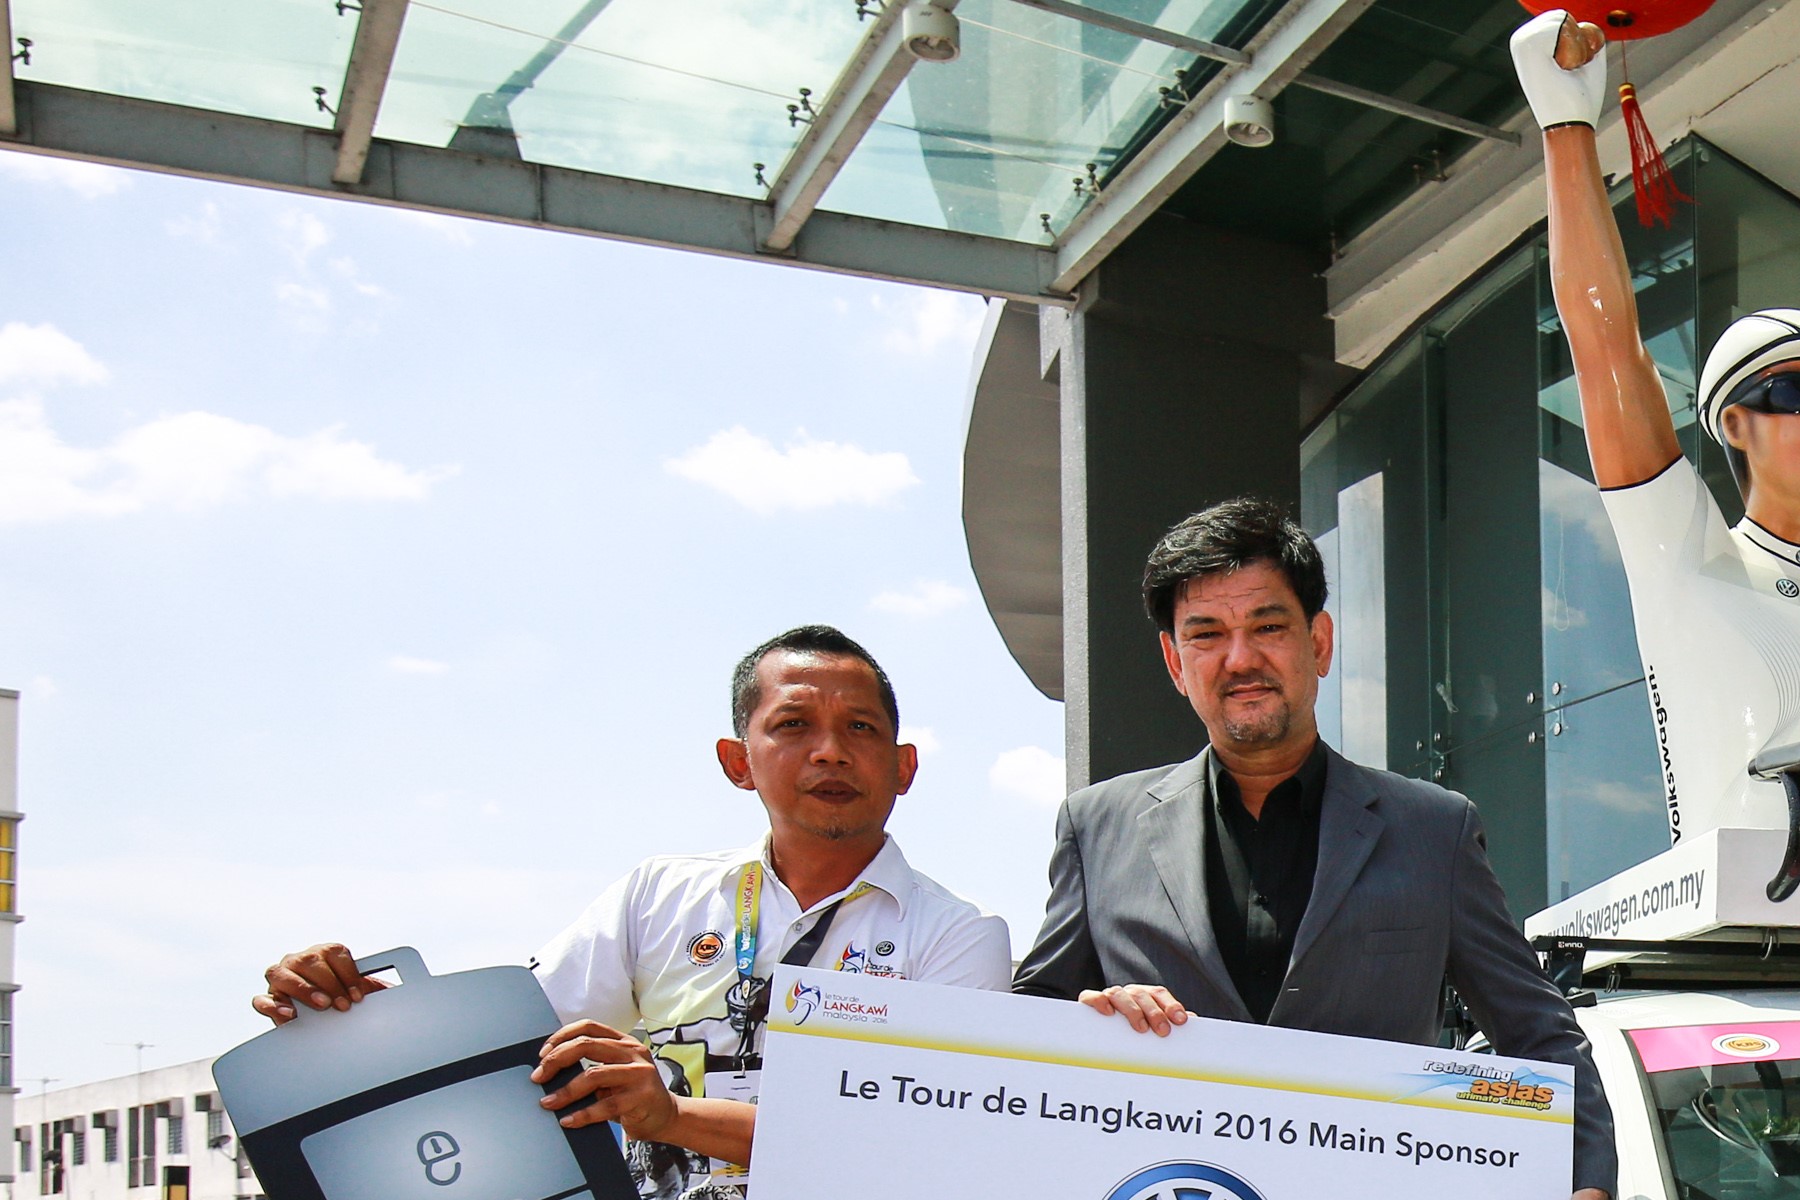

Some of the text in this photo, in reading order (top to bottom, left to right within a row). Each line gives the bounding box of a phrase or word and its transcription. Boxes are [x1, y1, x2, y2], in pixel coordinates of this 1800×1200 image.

[823, 1010, 868, 1023] malaysia
[824, 1001, 888, 1017] LANGKAWI
[1423, 1060, 1513, 1083] redefining
[1456, 1092, 1551, 1111] ultimate challenge
[839, 1071, 1520, 1169] Le Tour de Langkawi 2016 Main Sponsor
